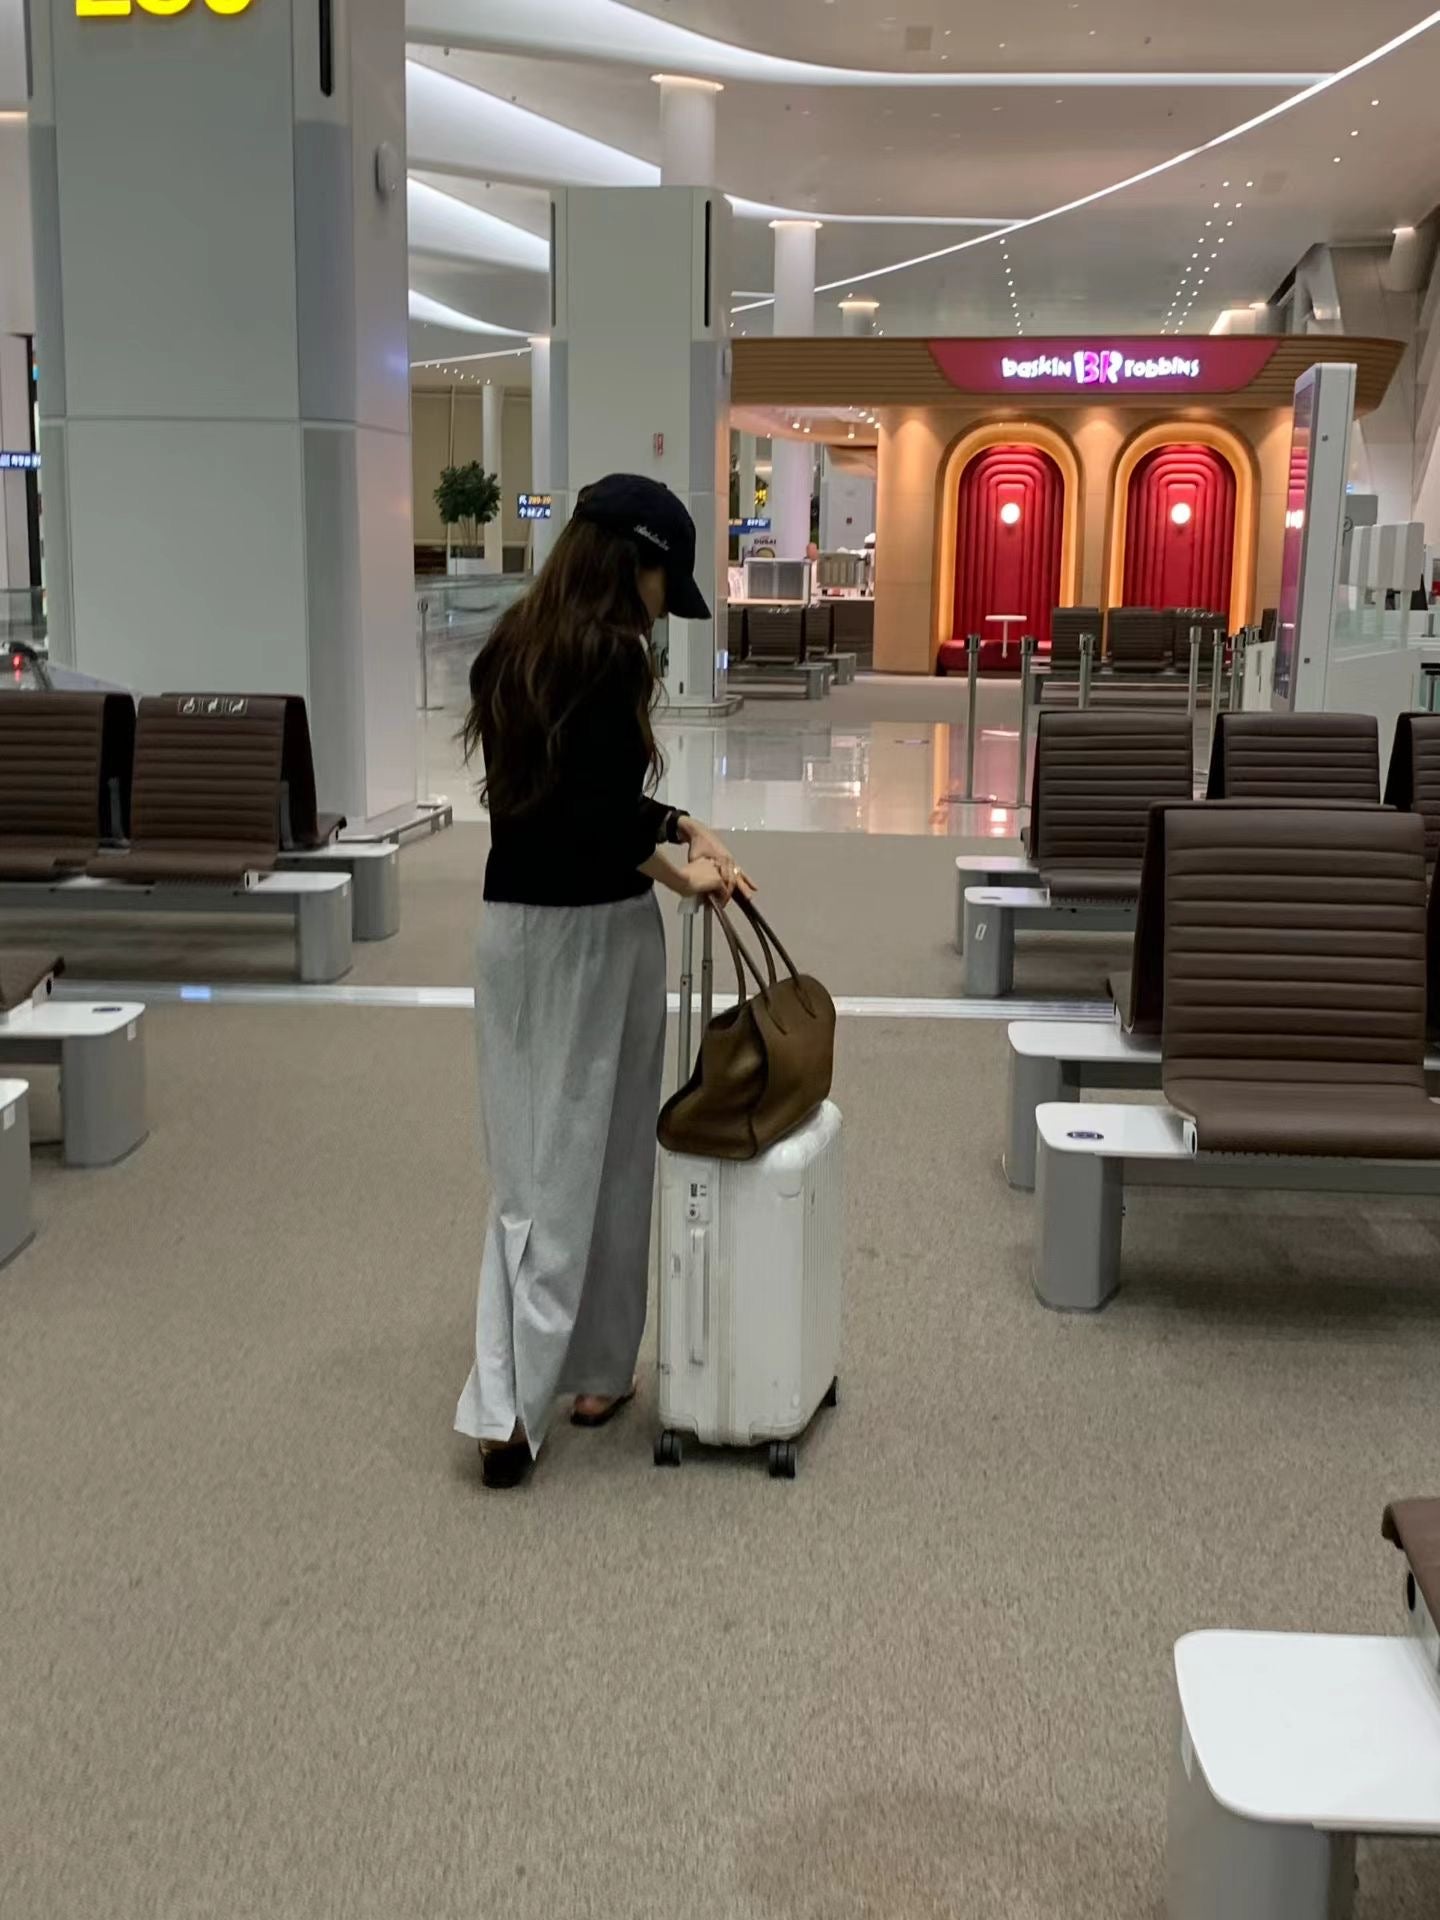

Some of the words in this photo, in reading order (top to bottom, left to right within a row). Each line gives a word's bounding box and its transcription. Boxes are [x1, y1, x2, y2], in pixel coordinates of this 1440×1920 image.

[1001, 355, 1072, 378] baskin
[1073, 350, 1124, 384] BR
[1124, 356, 1199, 378] robbins
